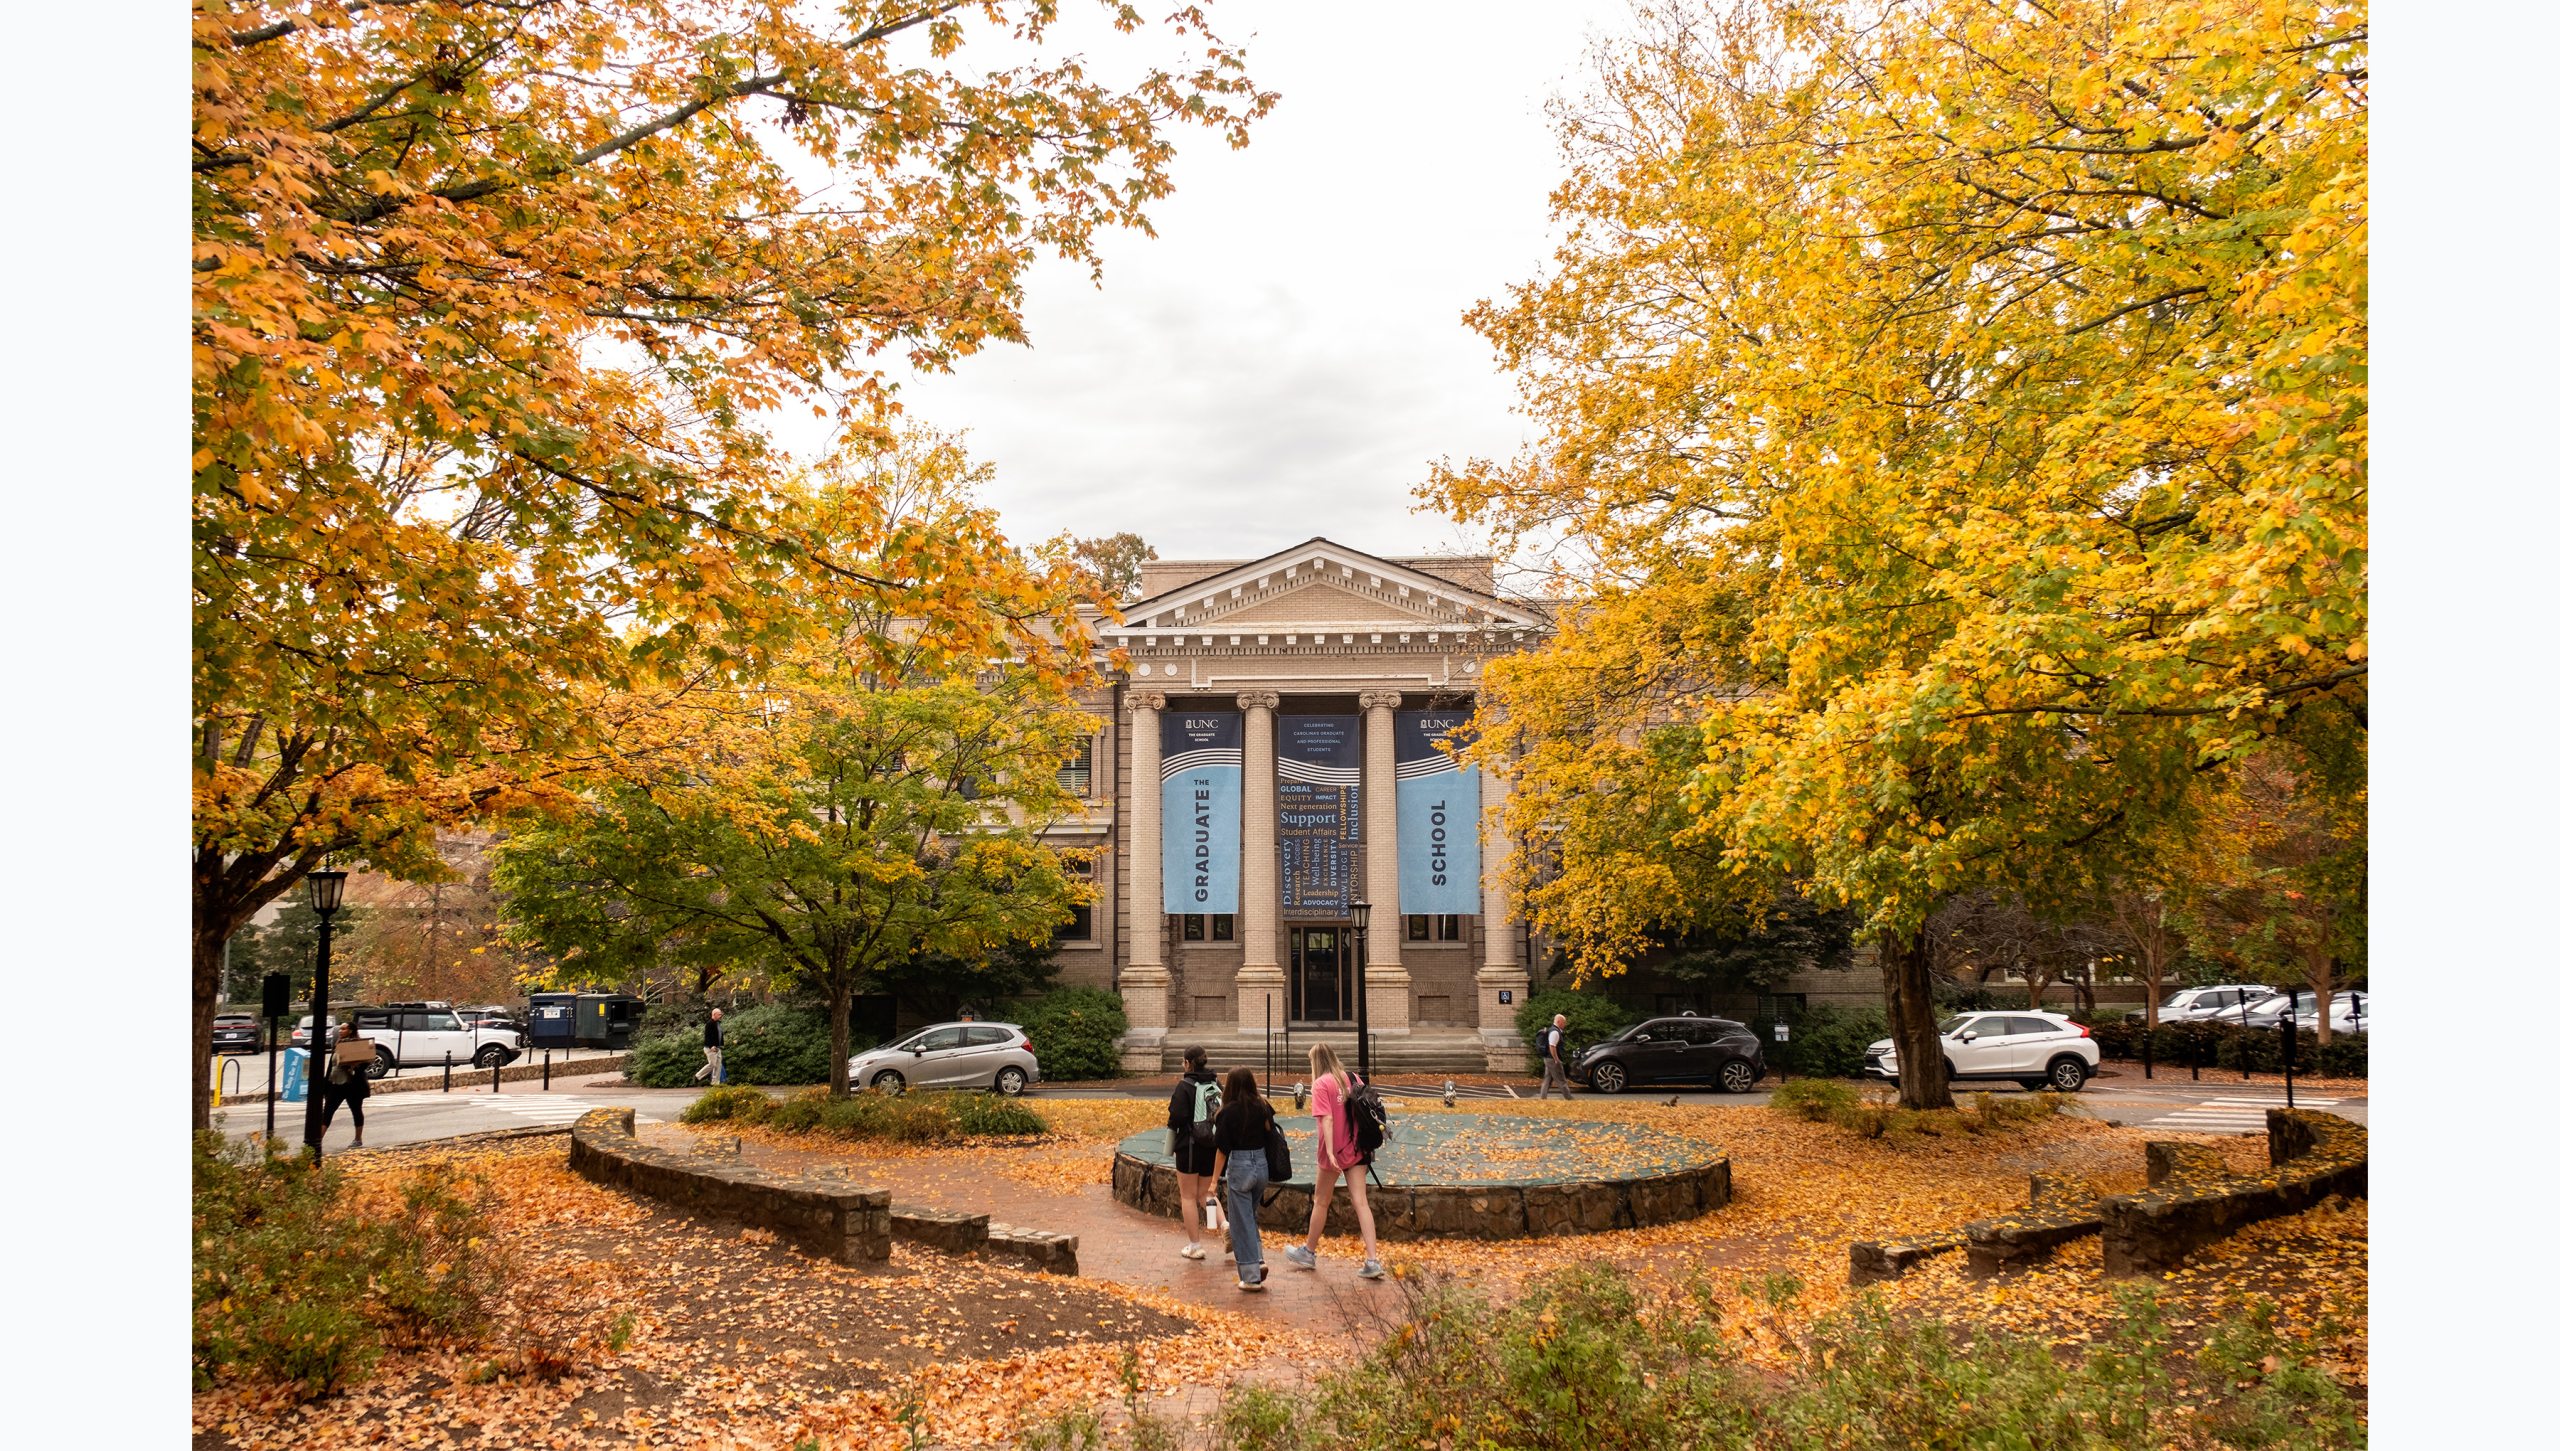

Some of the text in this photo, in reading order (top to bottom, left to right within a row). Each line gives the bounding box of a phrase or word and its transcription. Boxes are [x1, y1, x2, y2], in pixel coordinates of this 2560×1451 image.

[1192, 720, 1218, 728] UNC
[1428, 720, 1454, 728] UNC
[1299, 803, 1336, 811] generation
[1348, 785, 1358, 840] Inclusion
[1281, 812, 1336, 827] Support
[1195, 790, 1210, 902] GRADUATE
[1431, 800, 1446, 886] SCHOOL
[1312, 838, 1322, 886] Well-being
[1283, 839, 1293, 905] Discovery
[1303, 889, 1338, 897] Leadership
[1284, 908, 1338, 917] Interdisciplinary
